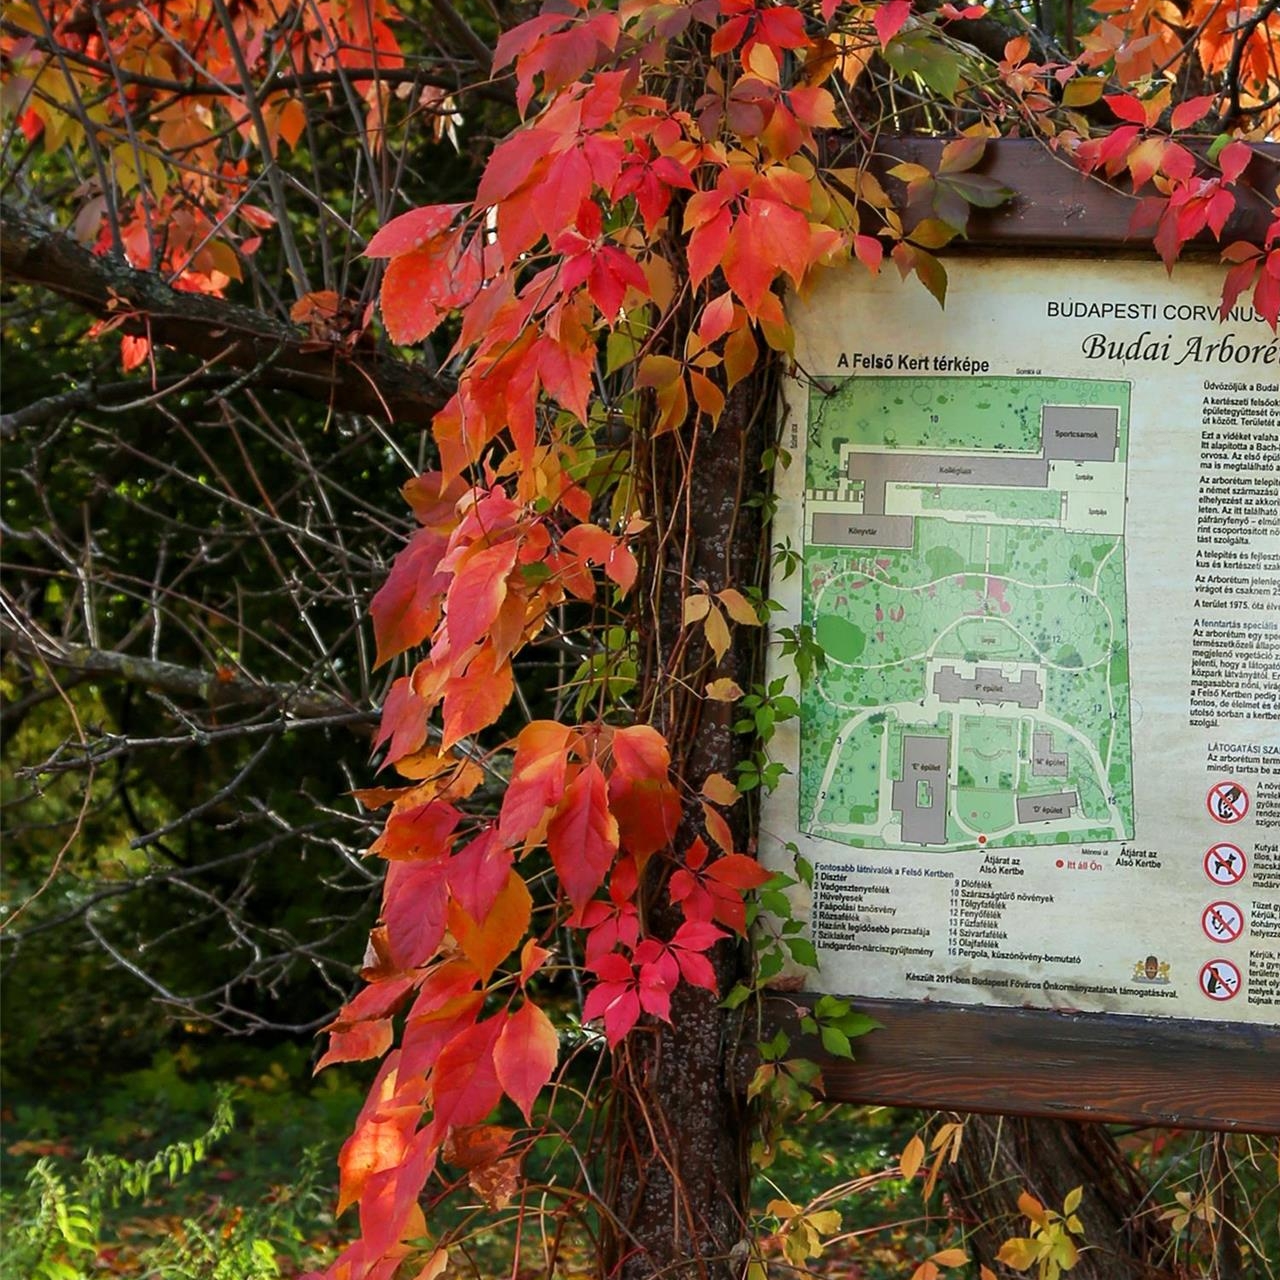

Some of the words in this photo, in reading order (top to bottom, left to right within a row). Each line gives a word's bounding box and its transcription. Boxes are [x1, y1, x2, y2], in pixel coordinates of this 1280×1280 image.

[1047, 302, 1157, 320] BUDAPESTI
[1081, 332, 1173, 360] Budai
[837, 354, 849, 368] A
[854, 354, 893, 369] Felső
[898, 355, 930, 371] Kert
[932, 356, 990, 374] térképe
[1204, 381, 1247, 392] Üdvözöljük
[1201, 601, 1227, 609] terület
[1229, 602, 1249, 610] 1975.
[1251, 602, 1264, 610] óta
[1201, 620, 1241, 629] fenntartás
[1208, 744, 1260, 754] LÁTOGATÁSI
[1219, 755, 1260, 764] arborétum
[1207, 764, 1234, 774] mindig
[1235, 766, 1258, 774] tartsa
[1120, 846, 1146, 859] Átjárat
[984, 854, 1009, 866] Átjárat
[1067, 861, 1076, 870] Itt
[1077, 862, 1088, 870] áll
[1089, 860, 1102, 871] Ön
[1115, 858, 1133, 867] Alsó
[1135, 859, 1161, 868] Kertbe
[814, 862, 855, 873] Fontosabb
[901, 867, 922, 876] Felső
[923, 868, 954, 878] Kertben
[979, 865, 997, 874] Alsó
[998, 866, 1024, 876] Kertbe
[815, 872, 818, 880] 1
[814, 881, 818, 890] 2
[820, 882, 890, 894] Vadgesztenyefélék
[955, 879, 959, 888] 9
[960, 879, 992, 889] Diófélék
[813, 892, 818, 900] 3
[819, 892, 863, 903] Hüvelyesek
[950, 889, 959, 898] 10
[960, 890, 1015, 902] Szárazságtűrő
[1016, 892, 1054, 904] növények
[813, 901, 817, 910] 4
[819, 902, 855, 913] Faápolási
[857, 904, 896, 916] tanösvény
[950, 898, 957, 907] 11
[960, 899, 1007, 910] Tölgyfafélék
[950, 908, 958, 917] 12
[959, 909, 1001, 920] Fenyőfélék
[818, 921, 846, 931] Hazánk
[949, 918, 957, 927] 13
[959, 918, 999, 928] Fűzfafélék
[811, 930, 816, 939] 7
[818, 931, 855, 941] Sziklakert
[949, 928, 957, 937] 14
[948, 938, 957, 947] 15
[958, 938, 999, 949] Olajfafélék
[948, 947, 956, 956] 16
[958, 948, 989, 959] Pergola,
[991, 950, 1081, 964] kúszónövény-bemutató
[906, 974, 934, 983] Készült
[971, 978, 1008, 989] Budapest
[1010, 980, 1041, 990] Főváros
[1119, 987, 1178, 998] támogatásával.
